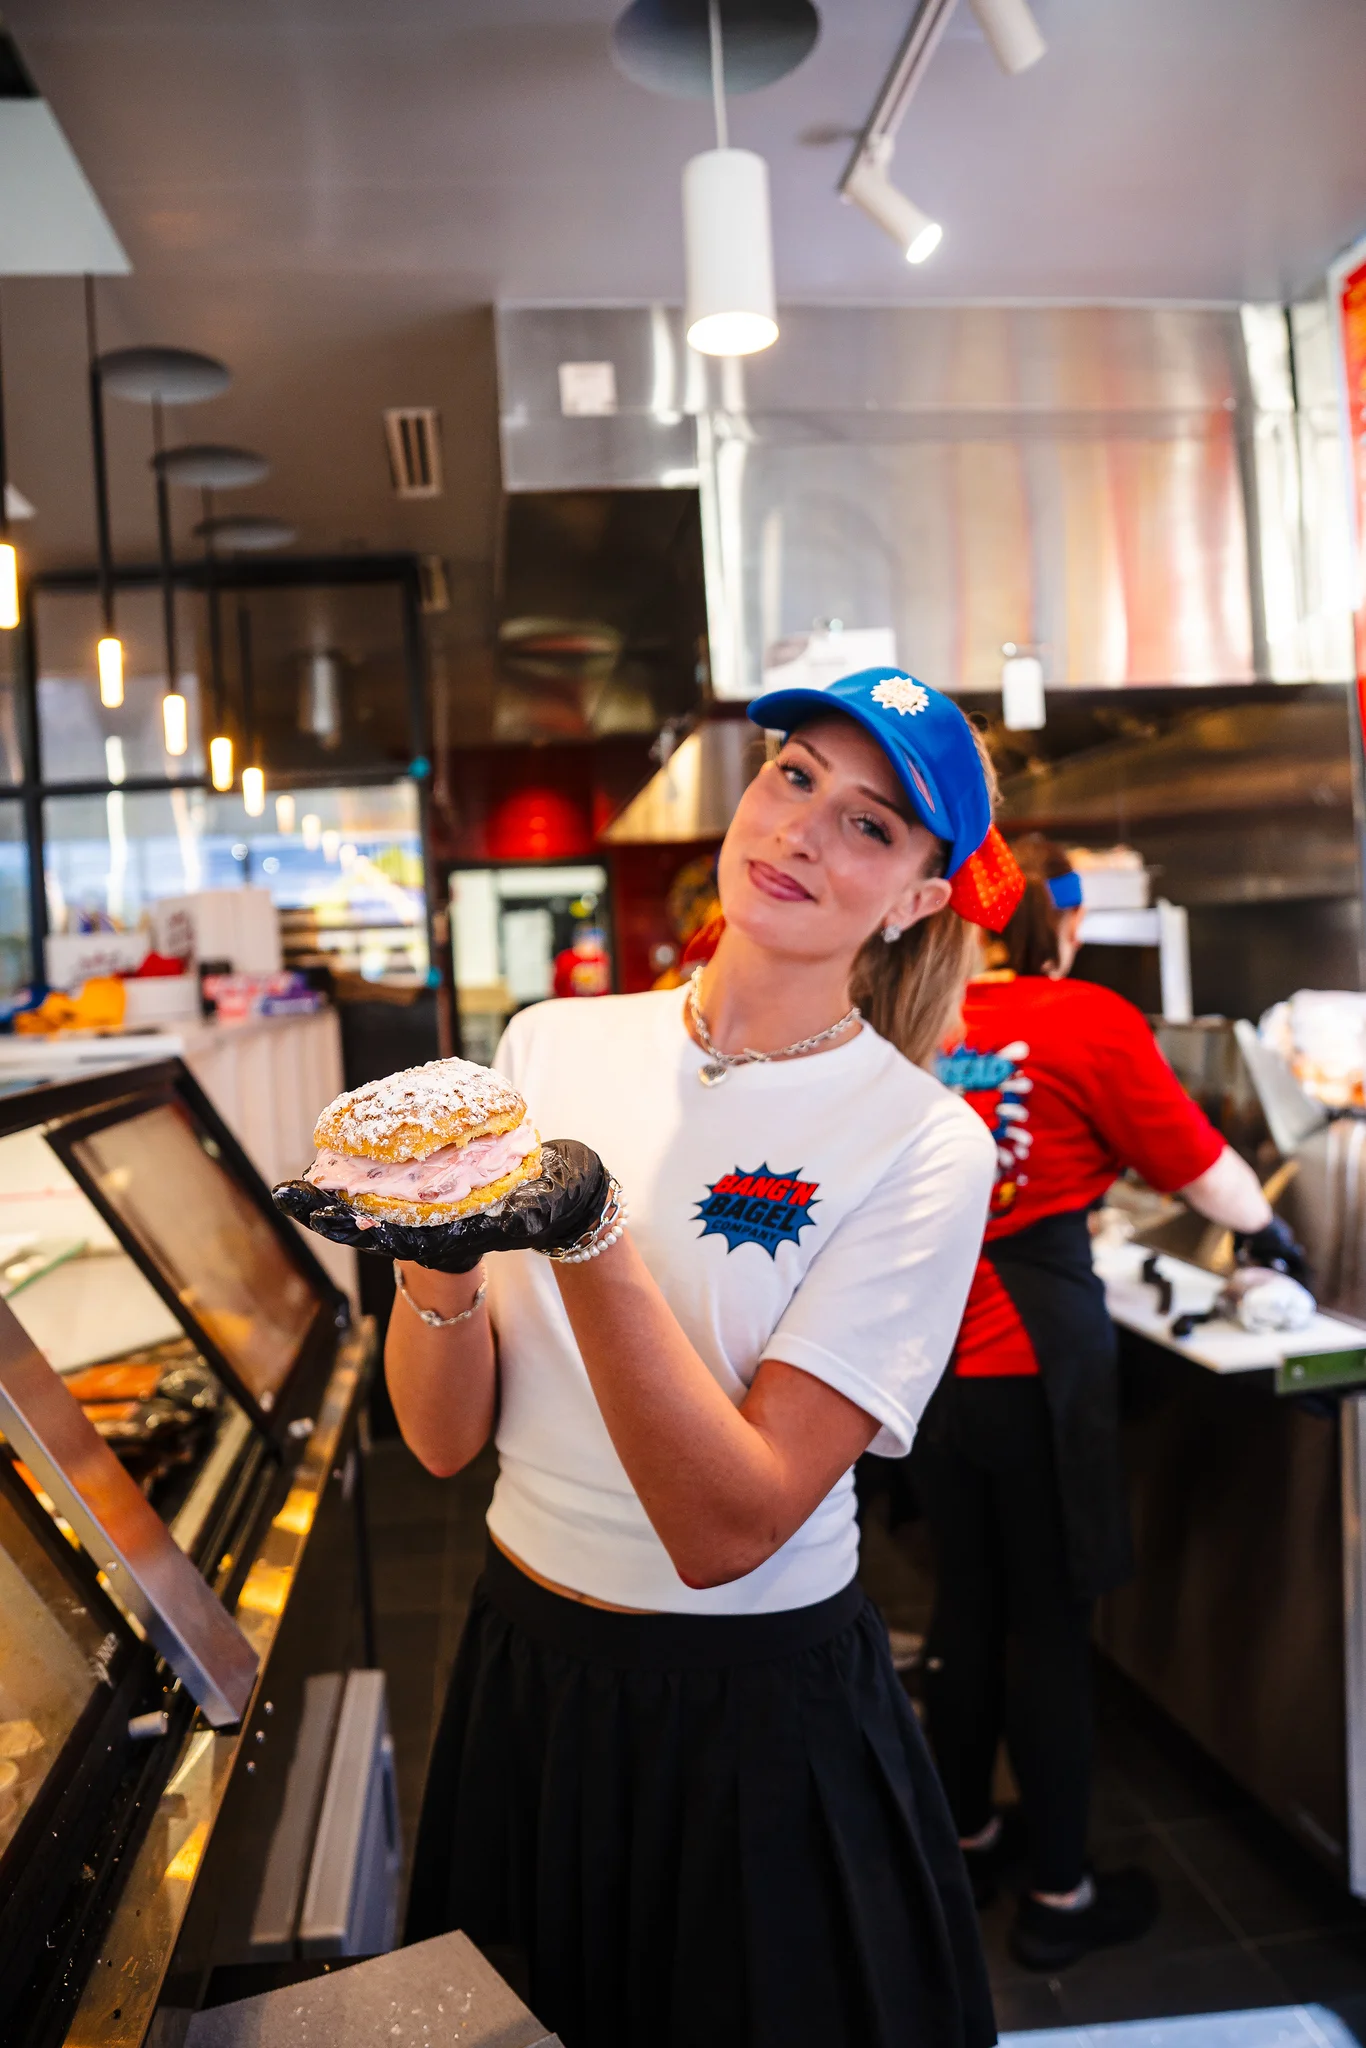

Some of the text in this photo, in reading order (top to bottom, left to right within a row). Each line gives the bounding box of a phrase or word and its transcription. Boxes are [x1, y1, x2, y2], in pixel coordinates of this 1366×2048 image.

[711, 1174, 820, 1206] BANG'N
[705, 1195, 798, 1231] BAGEL
[711, 1220, 778, 1241] COMPANY
